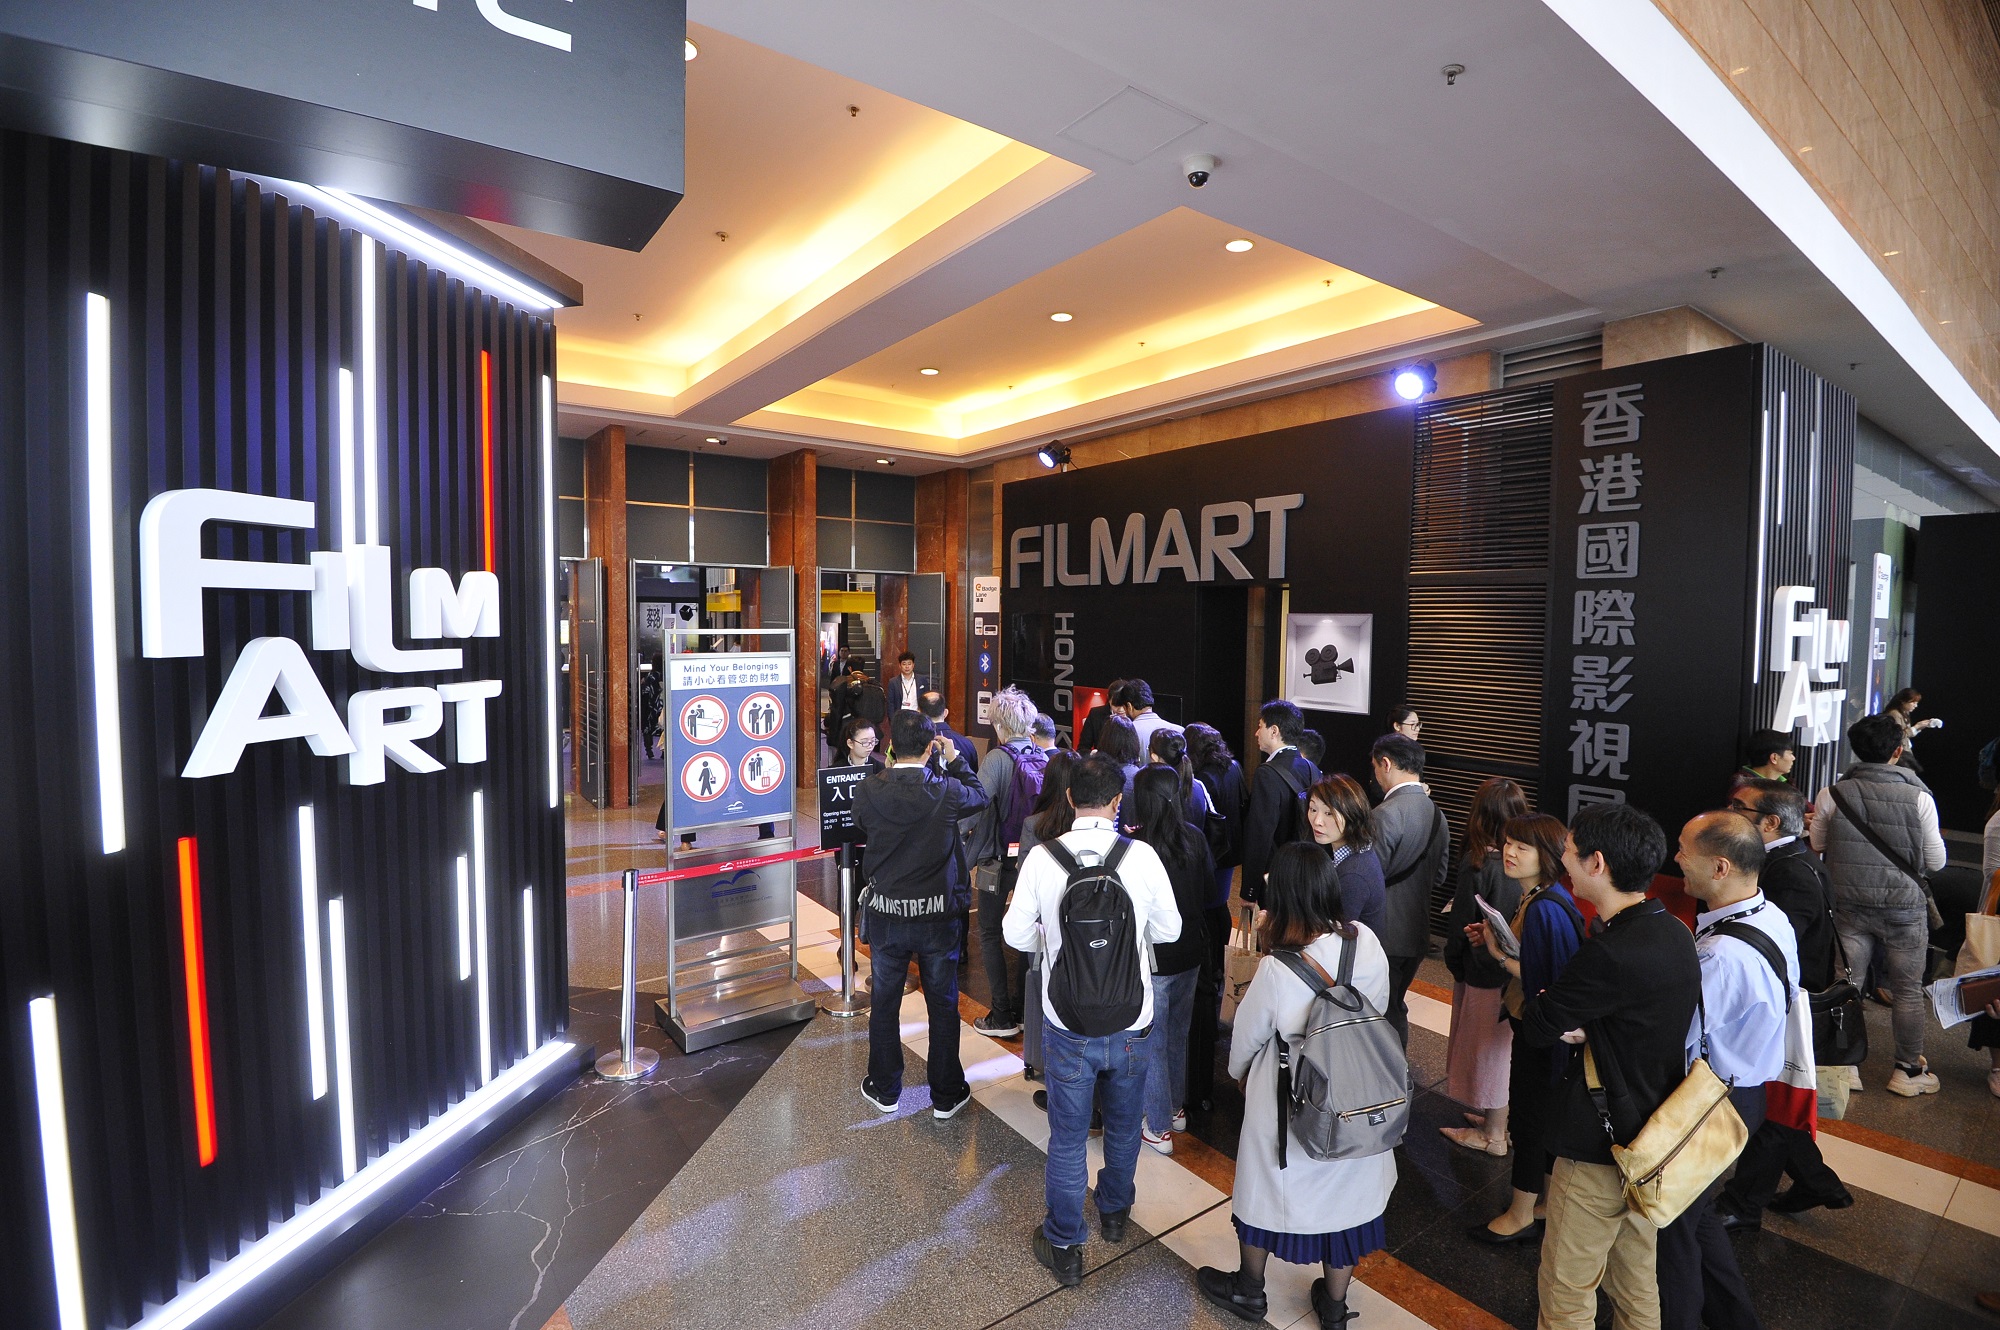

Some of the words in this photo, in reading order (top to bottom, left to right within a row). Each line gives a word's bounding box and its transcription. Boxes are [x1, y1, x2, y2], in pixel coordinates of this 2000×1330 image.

[139, 487, 501, 674] FILM
[1009, 493, 1305, 589] FILMART
[682, 672, 780, 687] 請小心看管您的財物
[683, 664, 706, 673] Mind
[709, 664, 729, 672] Your
[732, 662, 779, 672] Belongings
[1053, 612, 1075, 712] HONG
[1769, 585, 1850, 683] FILM
[180, 636, 503, 787] ART
[1771, 660, 1847, 748] ART
[826, 772, 866, 784] ENTRANCE
[868, 891, 945, 918] MAINSTREAM
